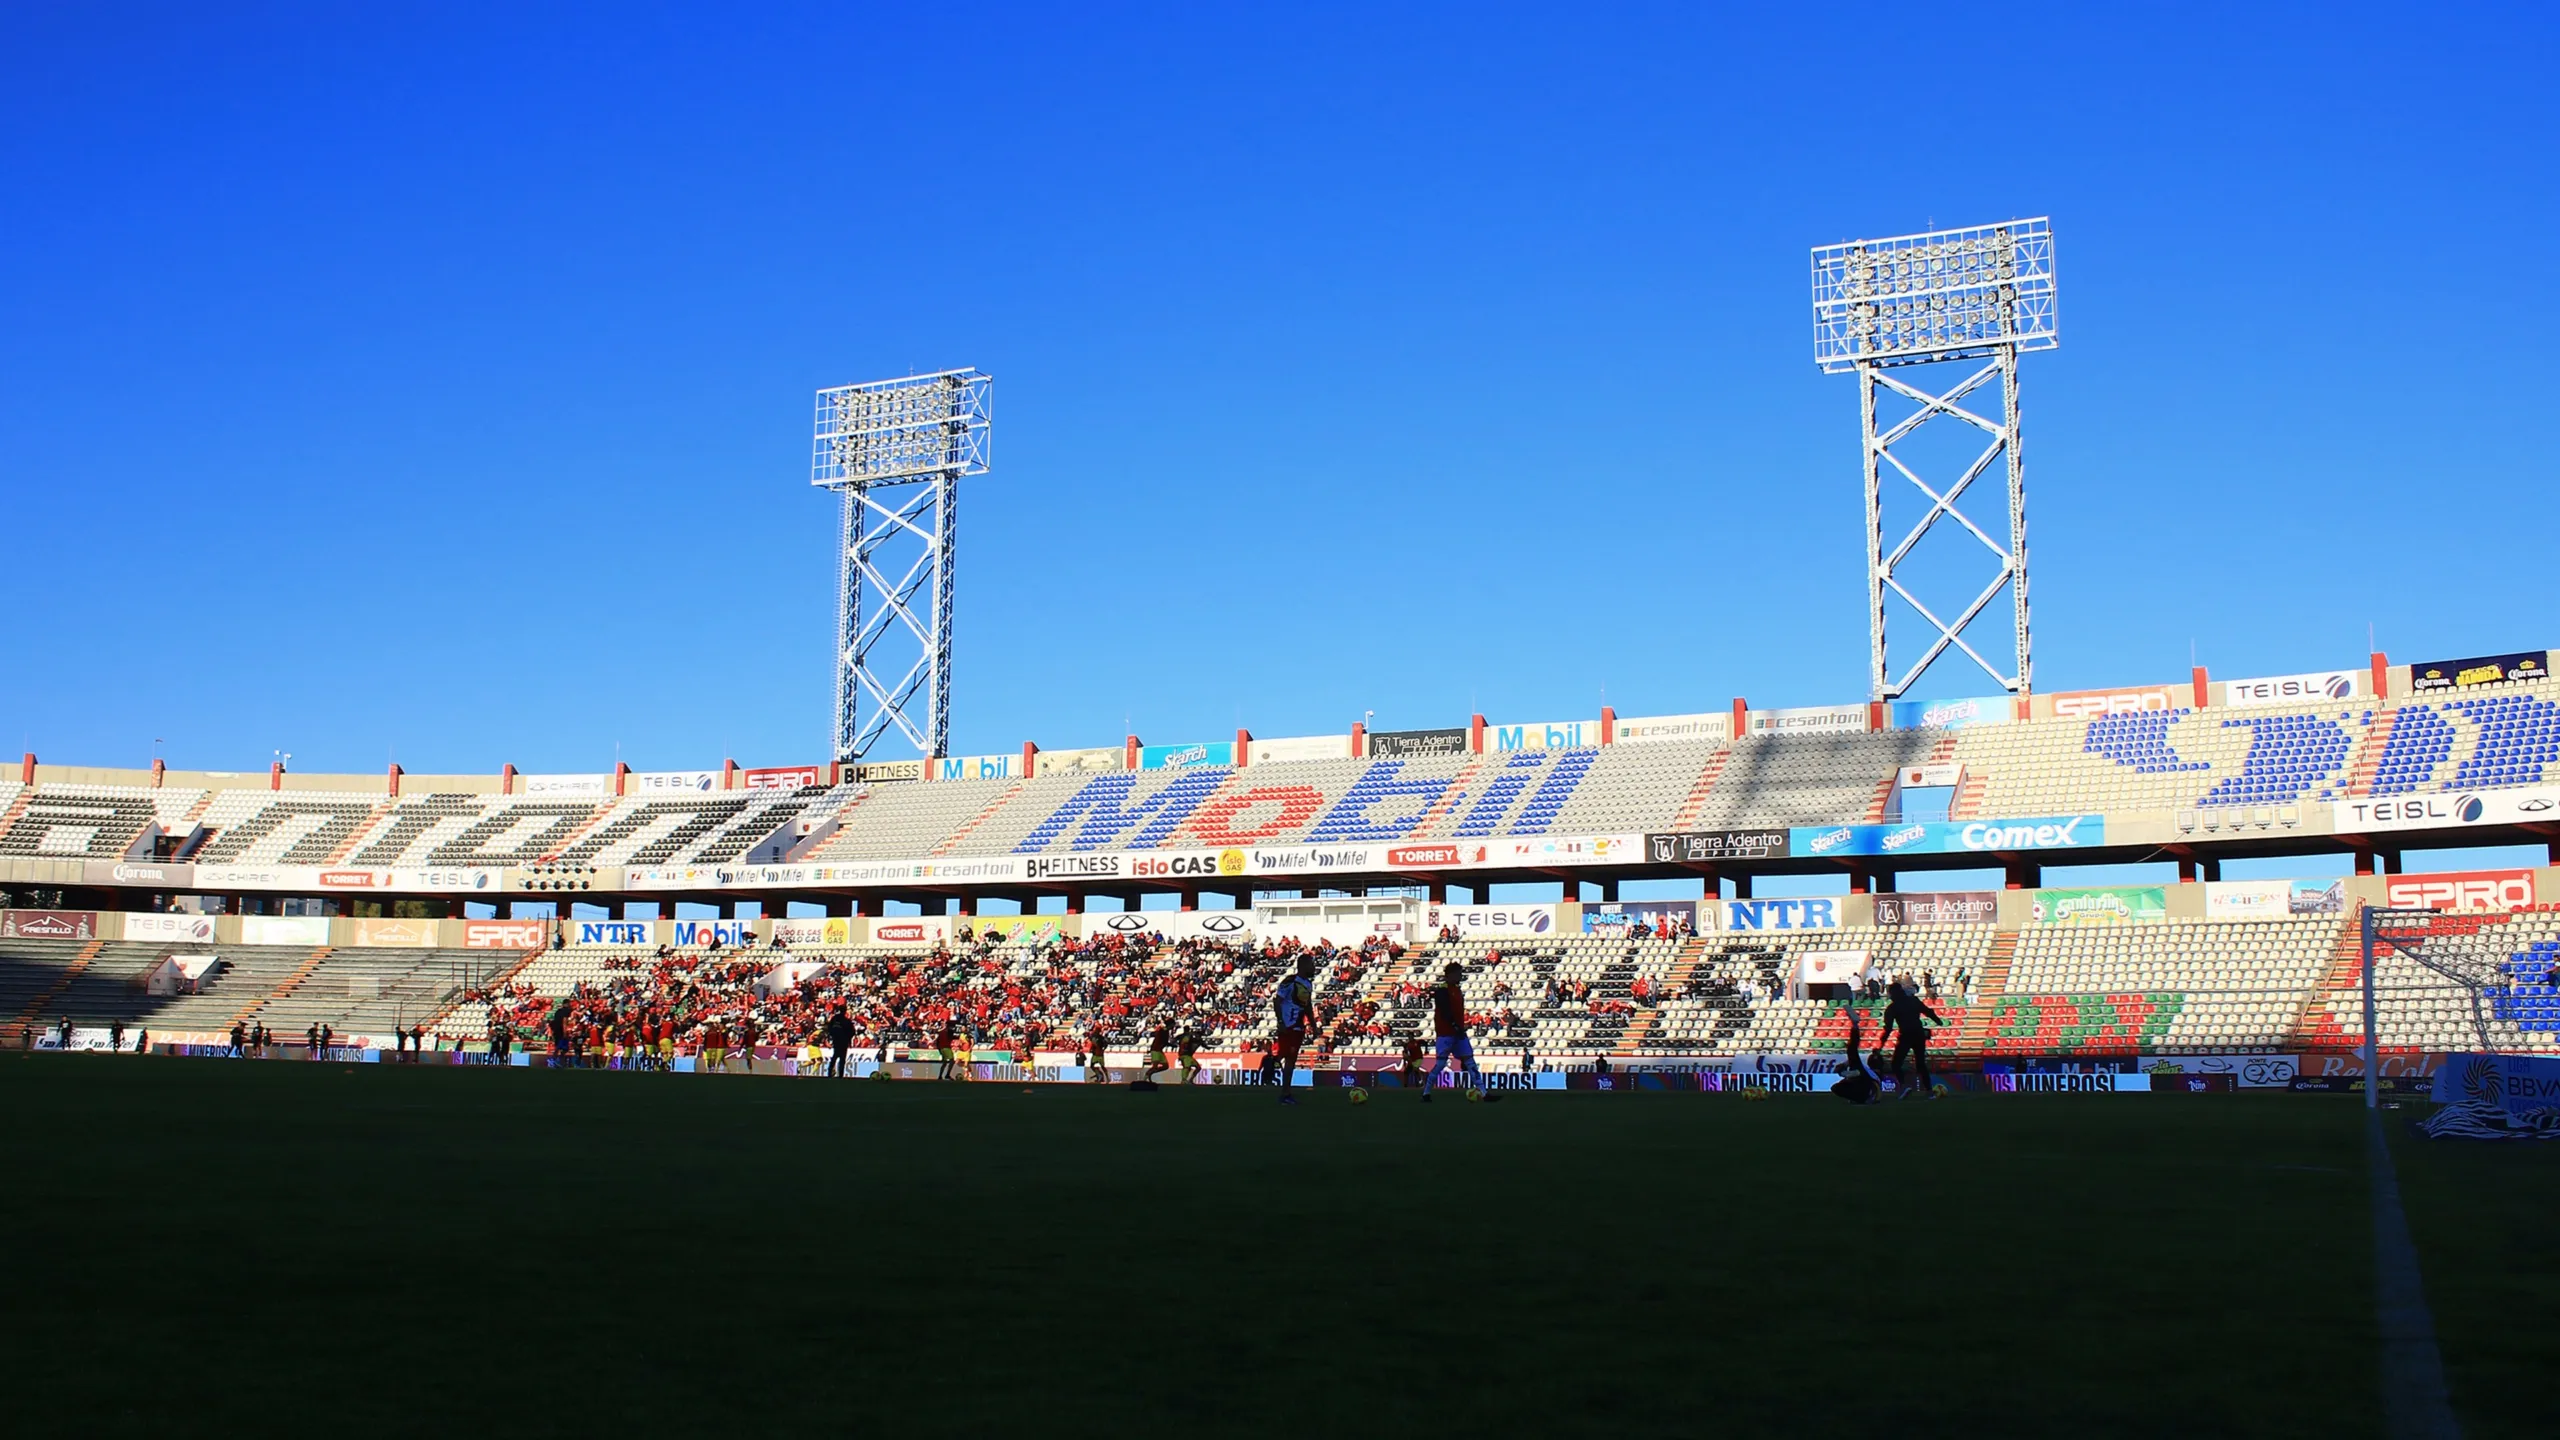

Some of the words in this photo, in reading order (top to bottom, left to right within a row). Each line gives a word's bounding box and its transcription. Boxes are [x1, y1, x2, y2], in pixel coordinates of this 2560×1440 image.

[2507, 668, 2546, 680] Corona
[2236, 681, 2320, 699] TEISL
[2414, 678, 2451, 689] Corona
[2055, 692, 2167, 717] SPIRO
[1775, 711, 1864, 728] cesantoni
[1920, 700, 1979, 728] Skarch
[1640, 720, 1725, 736] cesantoni
[1392, 736, 1422, 747] Tierra
[1424, 733, 1462, 746] Adentro
[1499, 724, 1582, 751] Mobil
[1164, 744, 1209, 768] Skarch
[943, 756, 1008, 779] Mobil
[644, 776, 693, 788] TEISL
[747, 771, 815, 789] SPIRO
[2352, 800, 2446, 821] TEISL
[1680, 835, 1723, 849] Tierra
[1725, 833, 1782, 848] Adentro
[1810, 827, 1852, 853] Skarch
[1882, 825, 1925, 851] Skarch
[1961, 816, 2084, 850] Comex
[1278, 853, 1308, 868] Mifel
[1336, 851, 1367, 866] Mifel
[1396, 850, 1453, 862] TORREY
[112, 864, 165, 881] Corona
[833, 865, 910, 880] cesantoni
[933, 861, 1015, 877] cesantoni
[1132, 858, 1169, 876] islo
[1171, 856, 1217, 874] GAS
[1225, 864, 1243, 872] GAS
[227, 873, 281, 882] CHIREY
[325, 874, 369, 885] TORREY
[419, 873, 470, 885] TEISL
[735, 868, 760, 884] Mifel
[780, 868, 806, 883] Mifel
[2390, 879, 2532, 909] SPIRO
[1901, 901, 1938, 913] Tierra
[1942, 900, 1993, 913] Adentro
[1453, 912, 1524, 926] TEISL
[1729, 900, 1836, 931] NTR
[23, 926, 72, 934] FRESNILLO
[130, 918, 189, 931] TEISL
[582, 923, 646, 943] NTR
[467, 926, 543, 947] SPIRO
[675, 922, 745, 945] Mobil
[880, 929, 921, 938] TORREY
[1797, 1059, 1840, 1073] Mif
